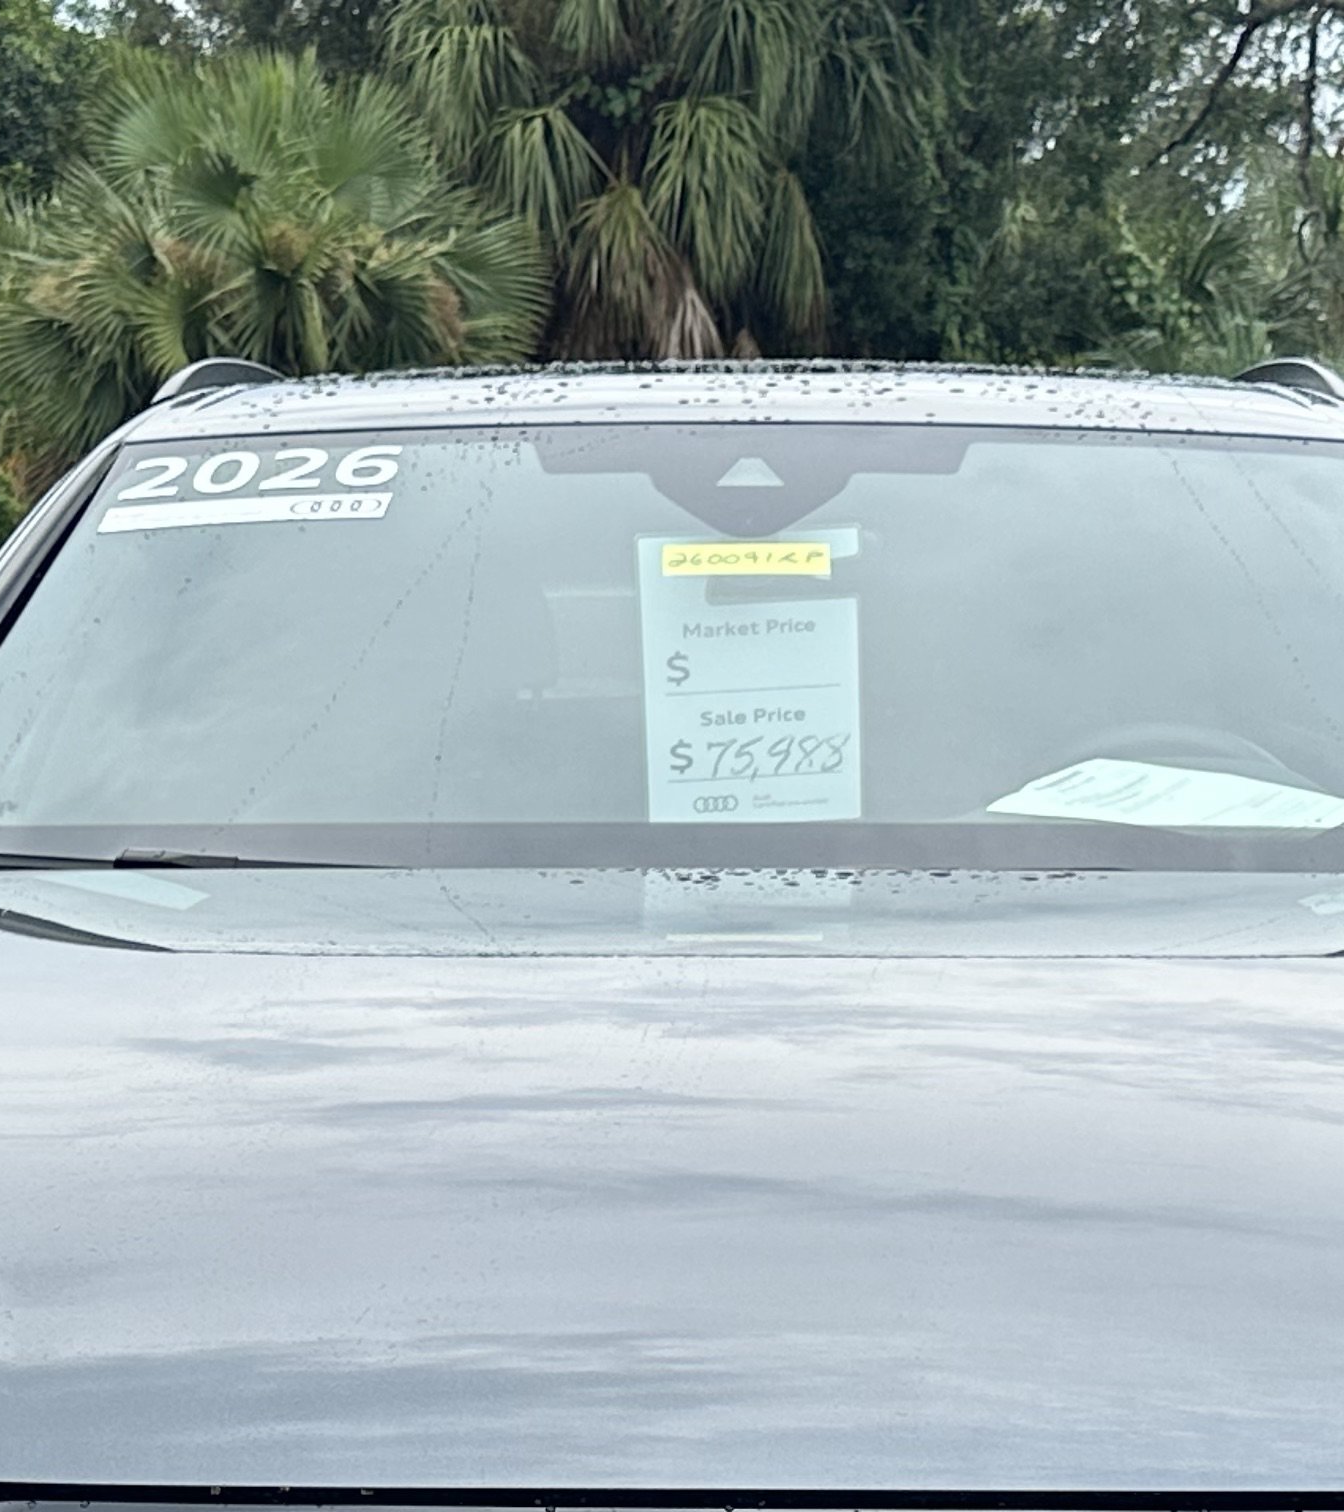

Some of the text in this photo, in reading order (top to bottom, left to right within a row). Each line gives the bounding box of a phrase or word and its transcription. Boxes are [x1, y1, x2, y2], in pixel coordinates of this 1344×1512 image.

[117, 445, 404, 501] 2026
[683, 618, 816, 640] Market Price
[666, 651, 691, 686] $
[700, 707, 806, 727] Sale Price
